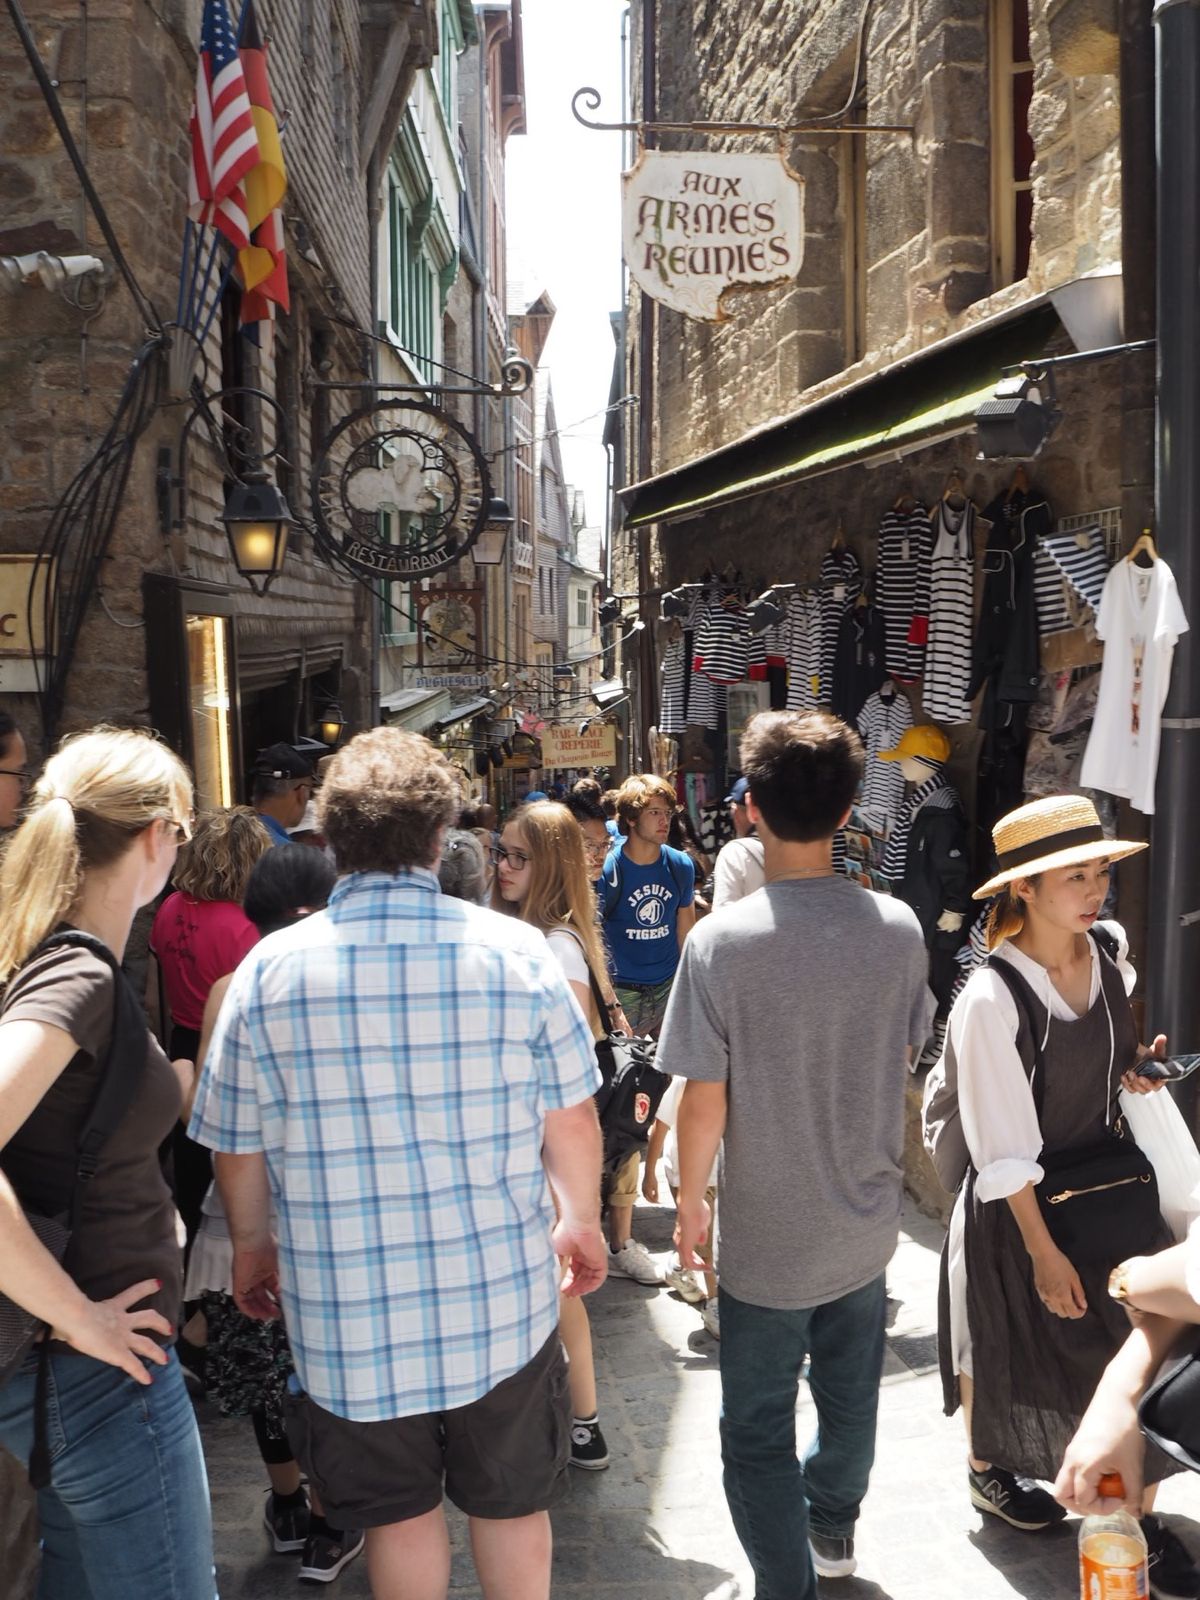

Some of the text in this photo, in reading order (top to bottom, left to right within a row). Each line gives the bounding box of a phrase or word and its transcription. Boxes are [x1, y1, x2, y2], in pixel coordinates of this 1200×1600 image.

[680, 170, 741, 200] AUX
[635, 195, 776, 239] ARMES
[347, 541, 451, 571] RESTAURANT
[628, 884, 673, 907] JESUIT
[625, 925, 670, 940] TIGERS
